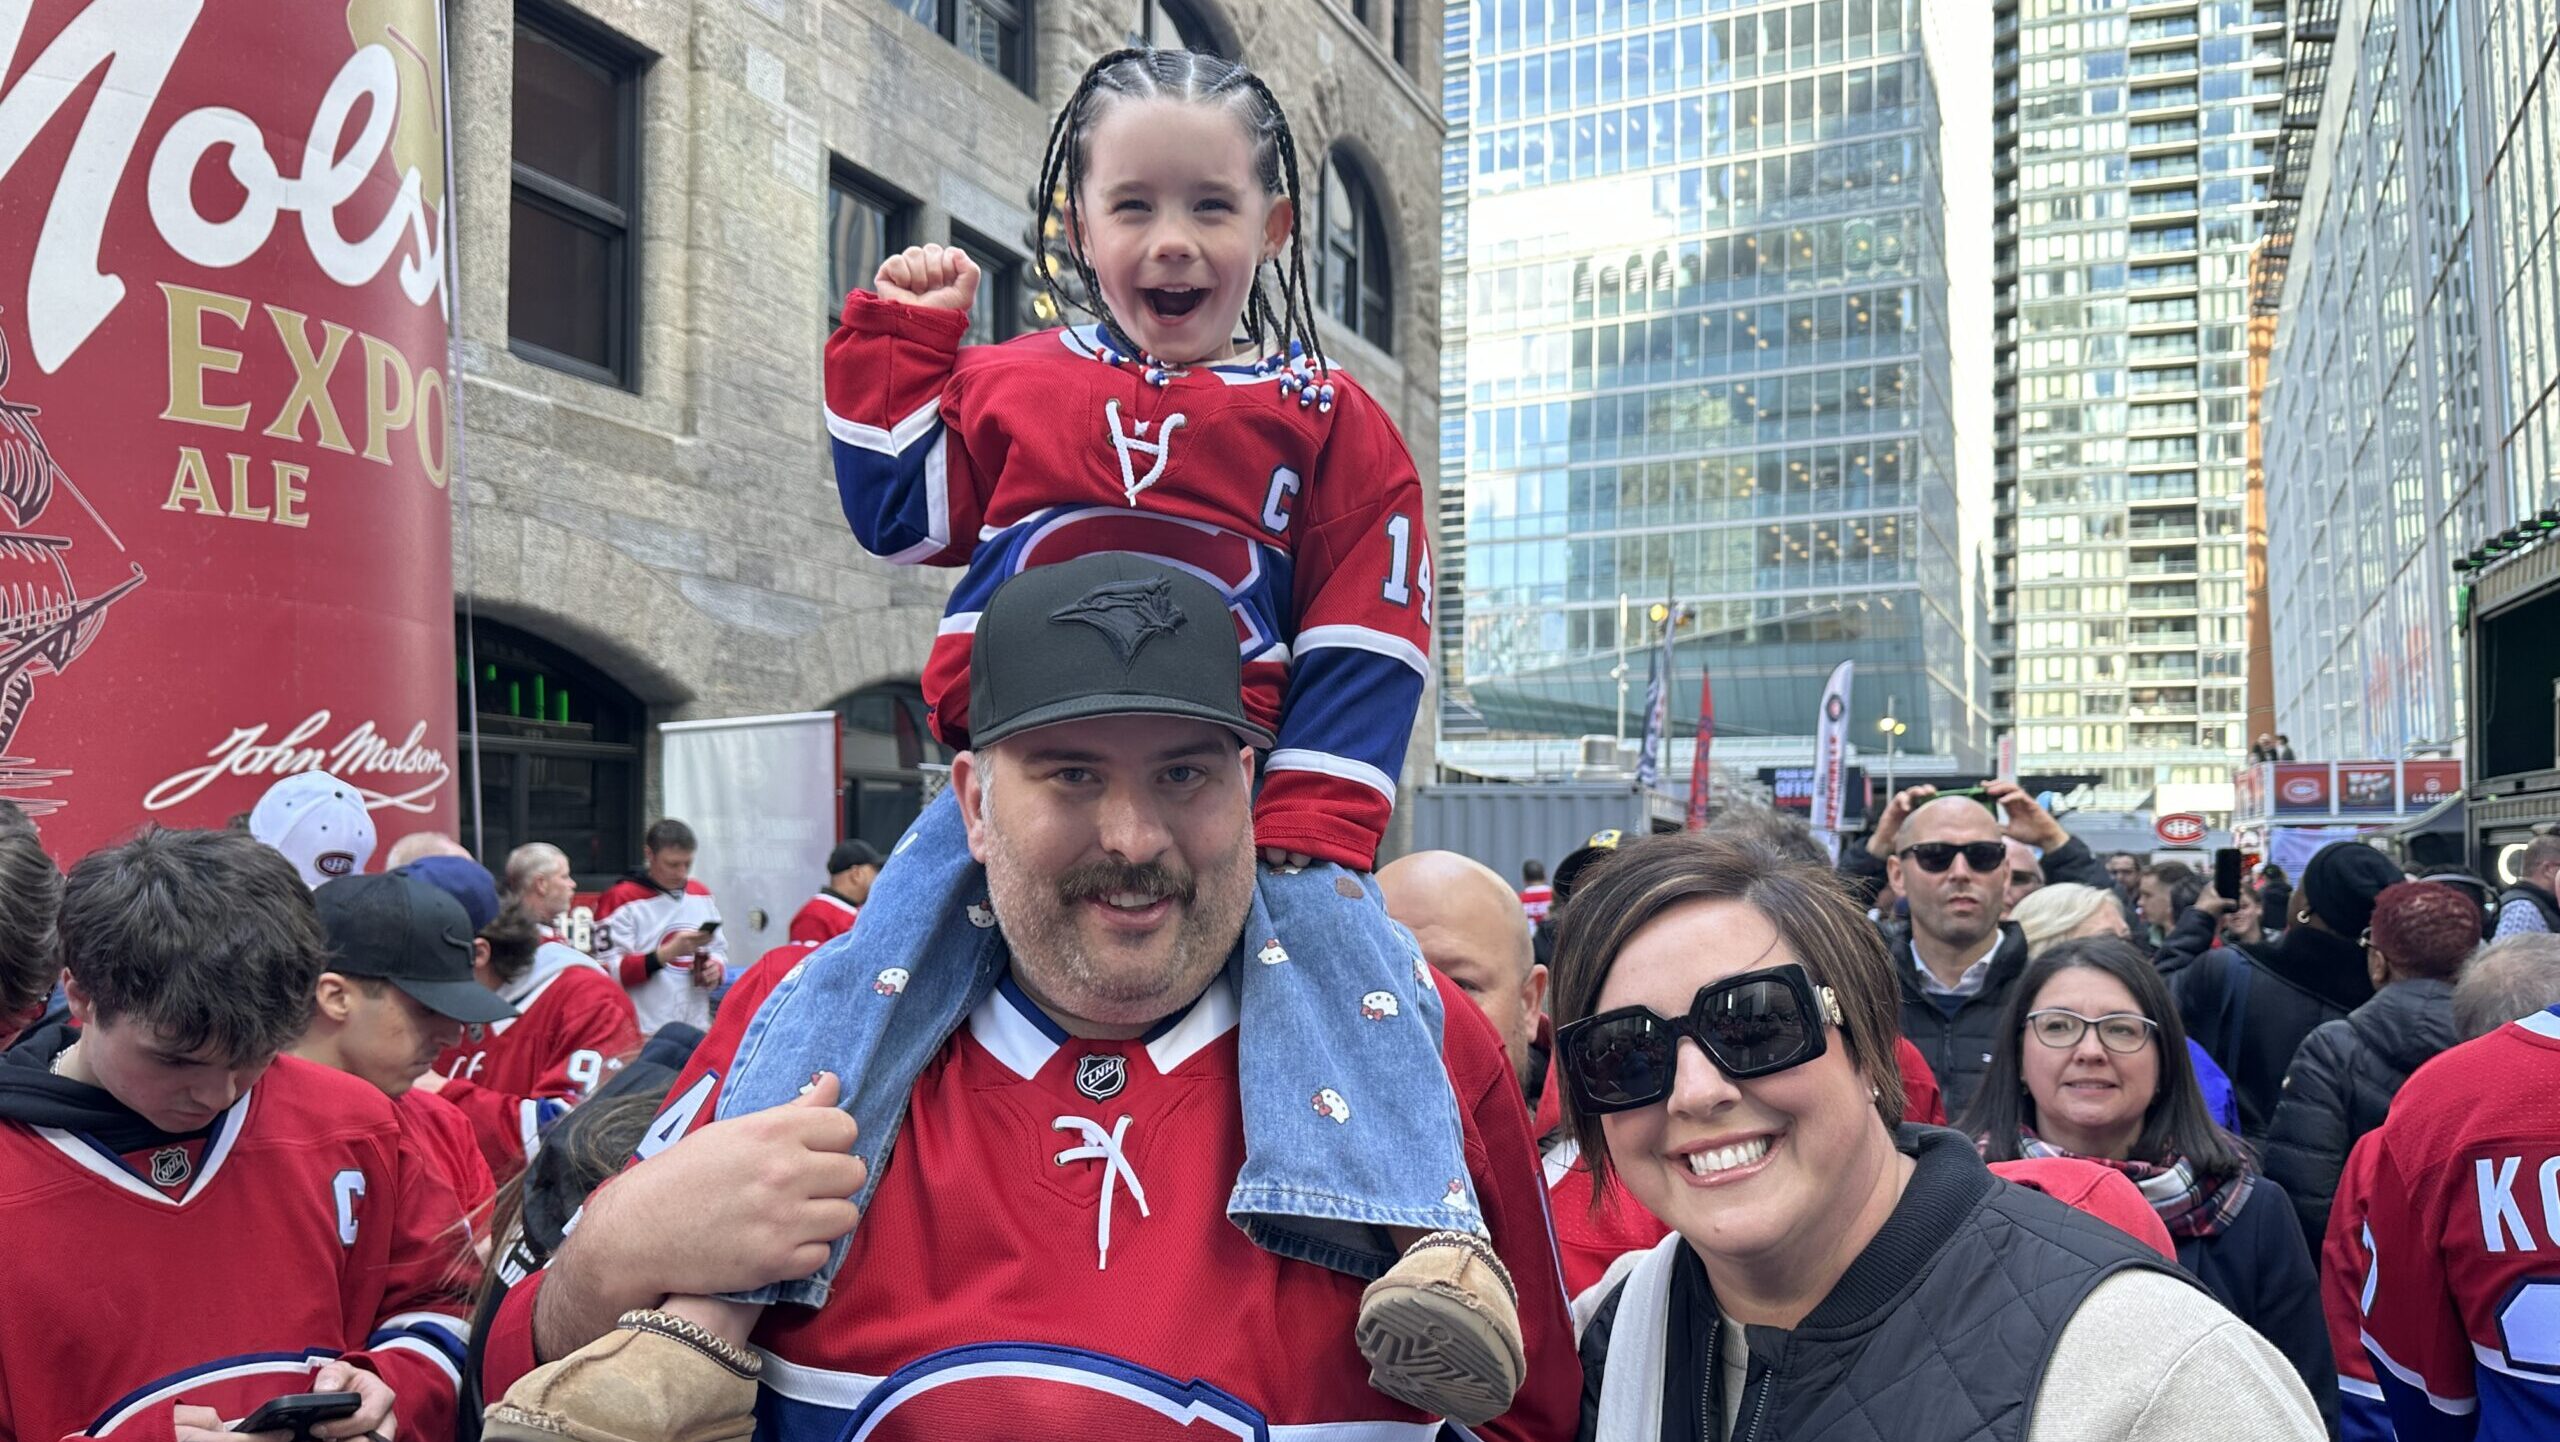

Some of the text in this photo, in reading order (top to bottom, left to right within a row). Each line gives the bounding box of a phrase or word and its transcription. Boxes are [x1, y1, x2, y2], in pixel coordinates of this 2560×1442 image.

[0, 0, 450, 375] Mols
[161, 446, 311, 528] ALE
[1262, 466, 1300, 533] C
[1383, 513, 1432, 627] 14
[1087, 1061, 1115, 1086] LNH
[331, 1169, 365, 1247] C
